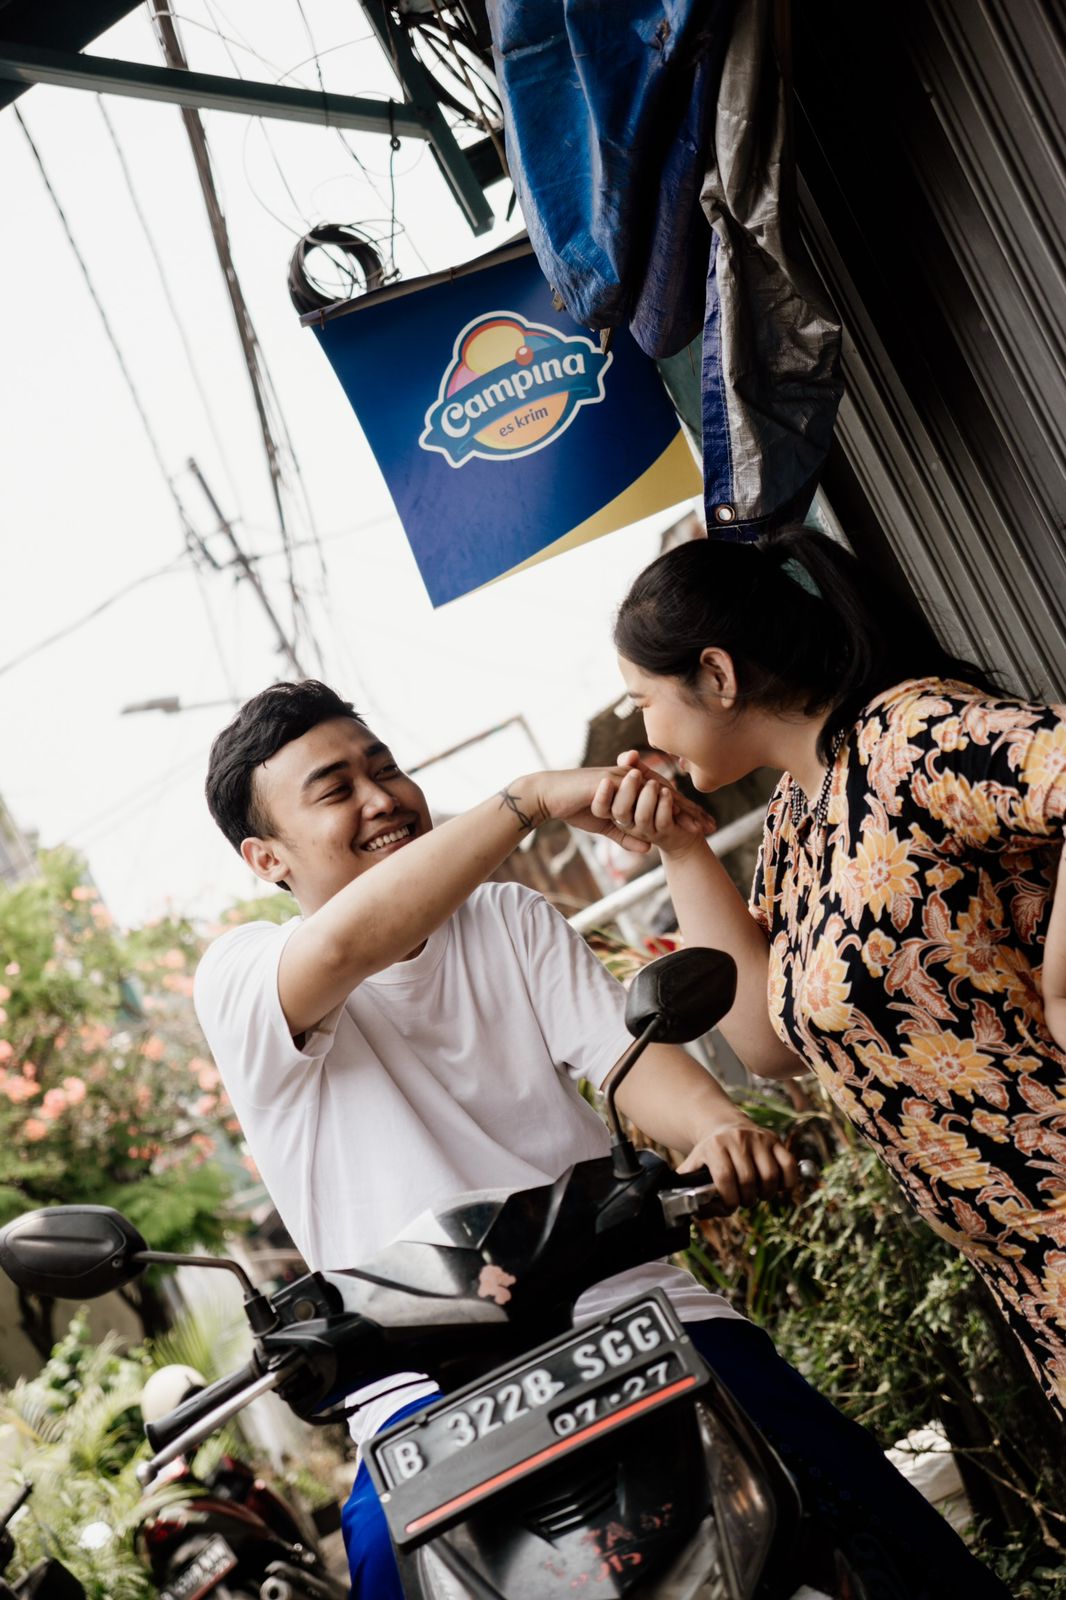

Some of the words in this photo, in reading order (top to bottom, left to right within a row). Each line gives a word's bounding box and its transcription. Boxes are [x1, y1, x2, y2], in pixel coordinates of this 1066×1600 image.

[440, 352, 586, 438] Campina
[498, 423, 515, 438] es
[514, 406, 550, 429] krim
[393, 1440, 425, 1480] B
[448, 1368, 557, 1448] 3228
[572, 1316, 661, 1381] SGG
